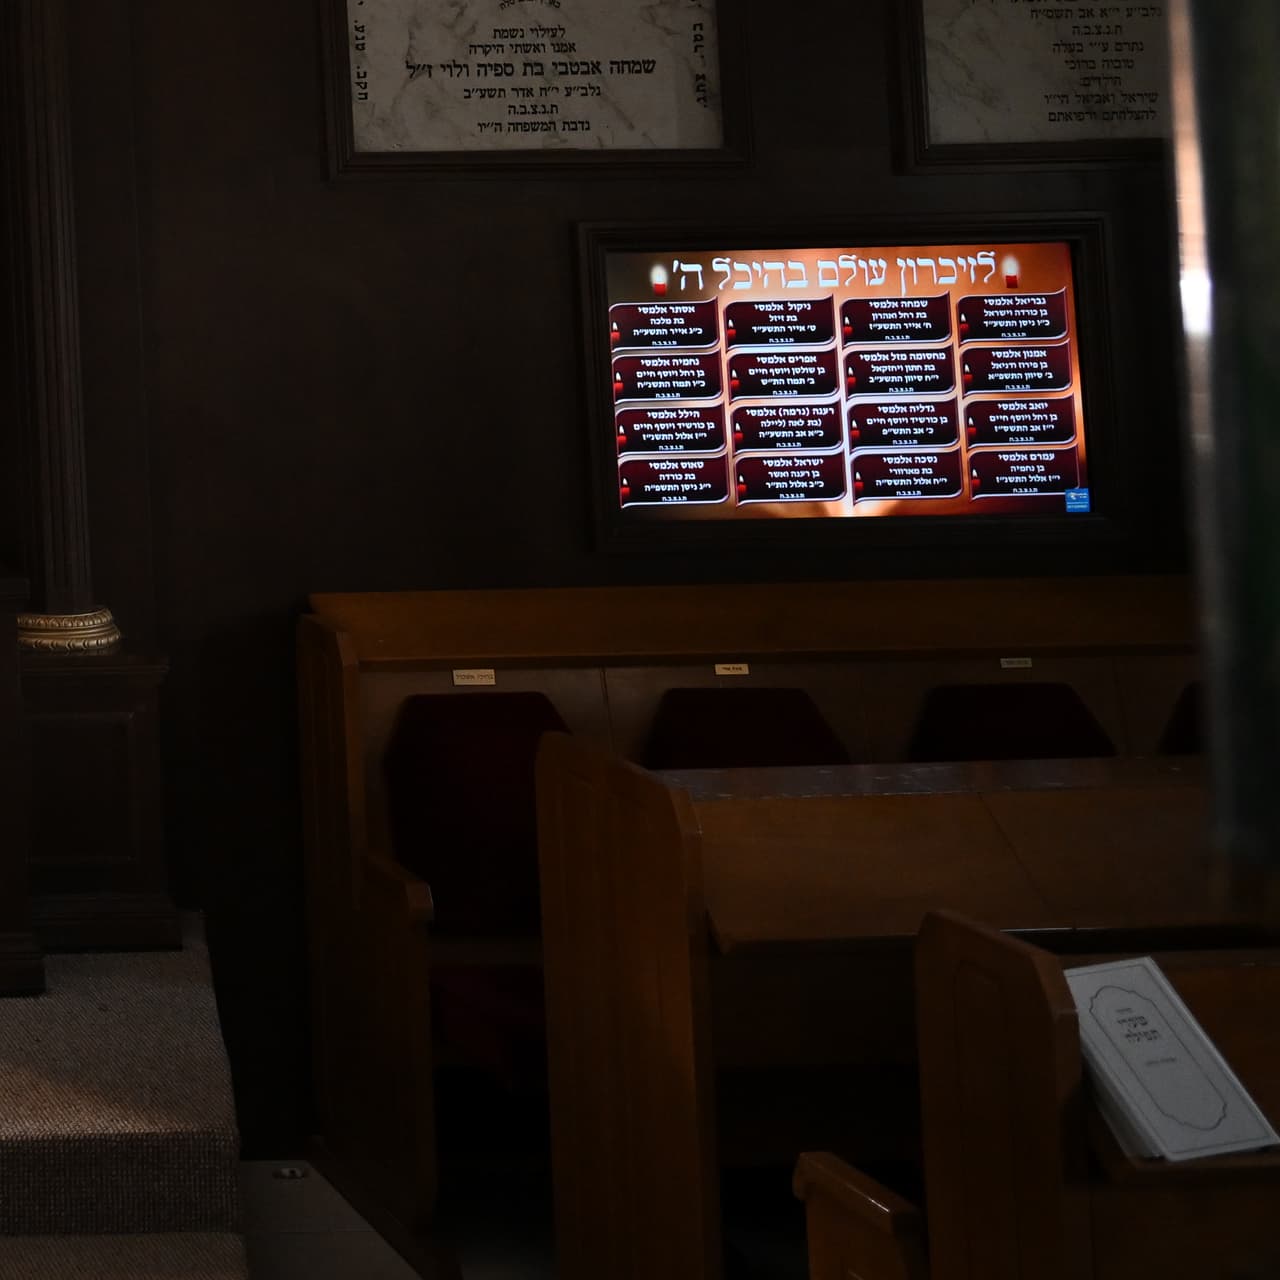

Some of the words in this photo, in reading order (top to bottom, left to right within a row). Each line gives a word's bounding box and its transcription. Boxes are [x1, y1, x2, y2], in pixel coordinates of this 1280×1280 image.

[468, 43, 505, 57] היקרה
[508, 42, 546, 55] ואשתי
[549, 41, 577, 54] אמנו
[672, 260, 704, 290] ה'
[712, 257, 808, 290] בהיכל
[817, 255, 887, 288] עולם
[896, 251, 996, 297] לזיכרון
